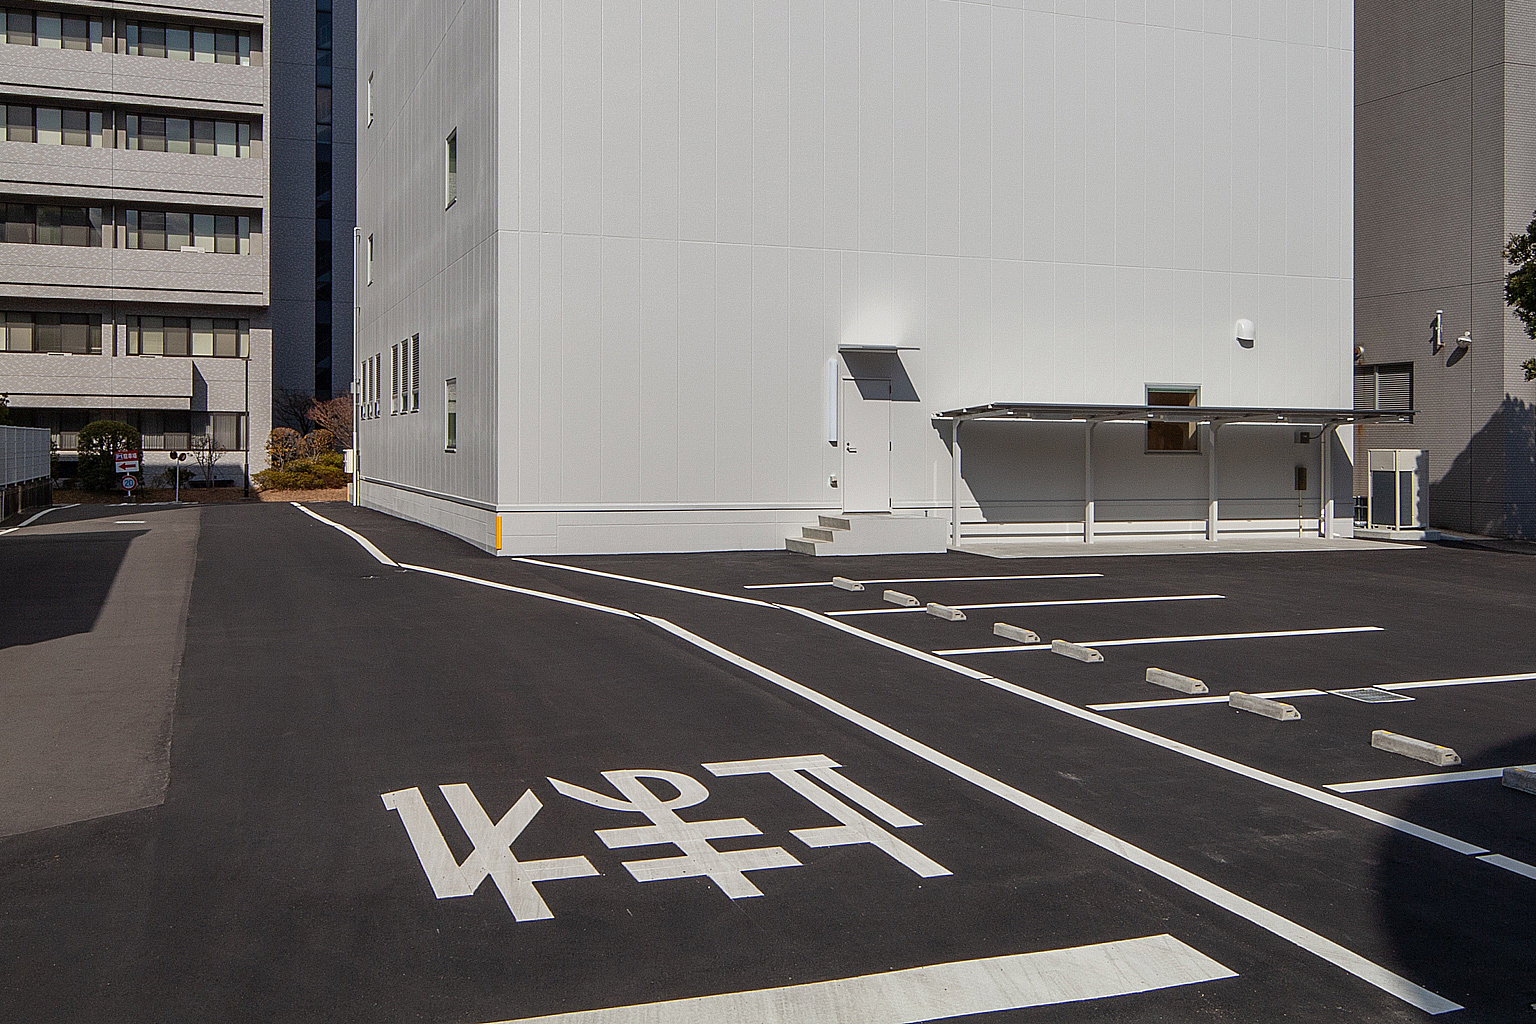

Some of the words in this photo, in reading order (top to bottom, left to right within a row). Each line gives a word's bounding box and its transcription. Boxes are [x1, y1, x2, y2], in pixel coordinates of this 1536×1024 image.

[124, 479, 134, 487] 20
[380, 754, 954, 922] 止まれ
